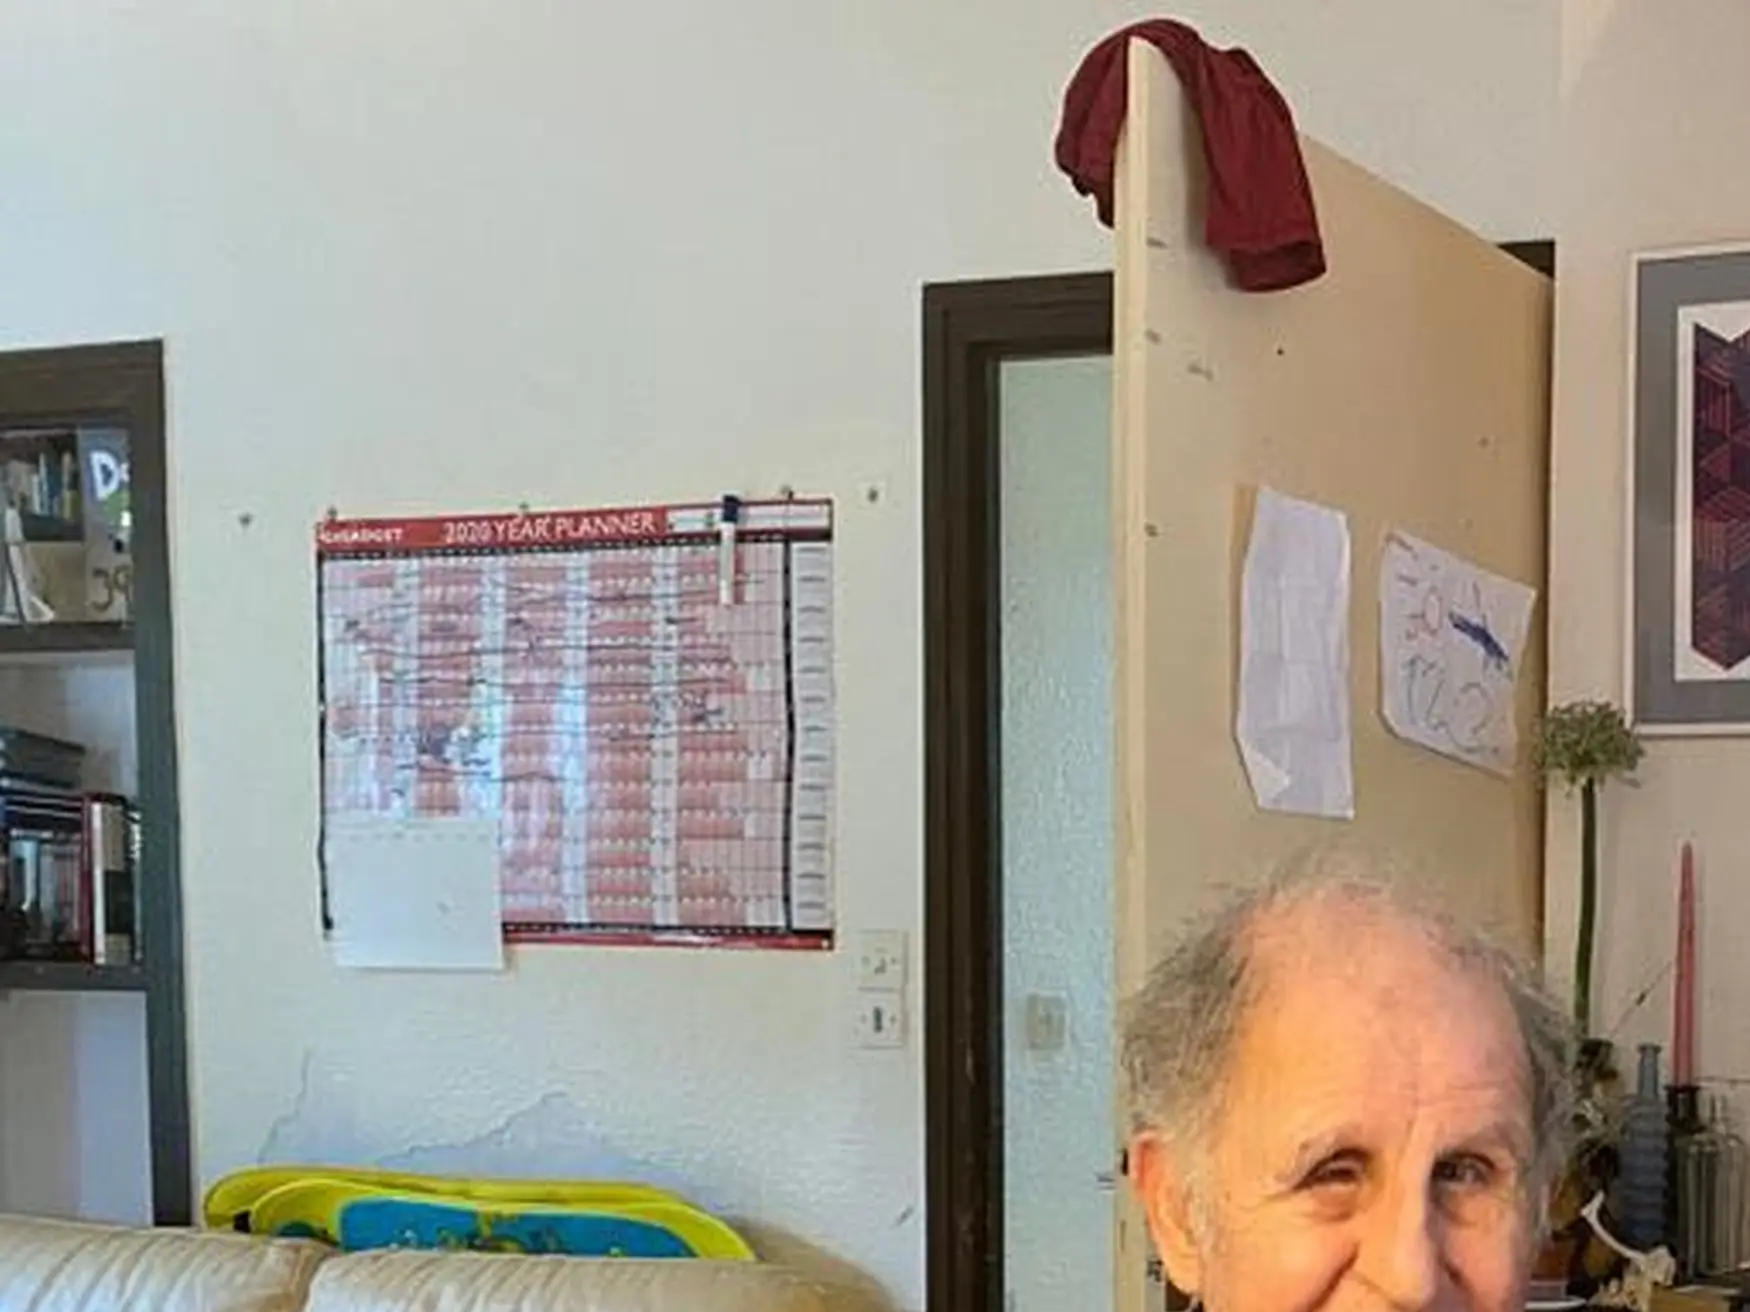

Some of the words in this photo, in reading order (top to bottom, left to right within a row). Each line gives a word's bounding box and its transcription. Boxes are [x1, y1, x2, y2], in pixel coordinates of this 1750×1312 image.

[443, 520, 494, 547] 2020
[494, 515, 551, 543] YEAR
[553, 511, 656, 540] PLANNER
